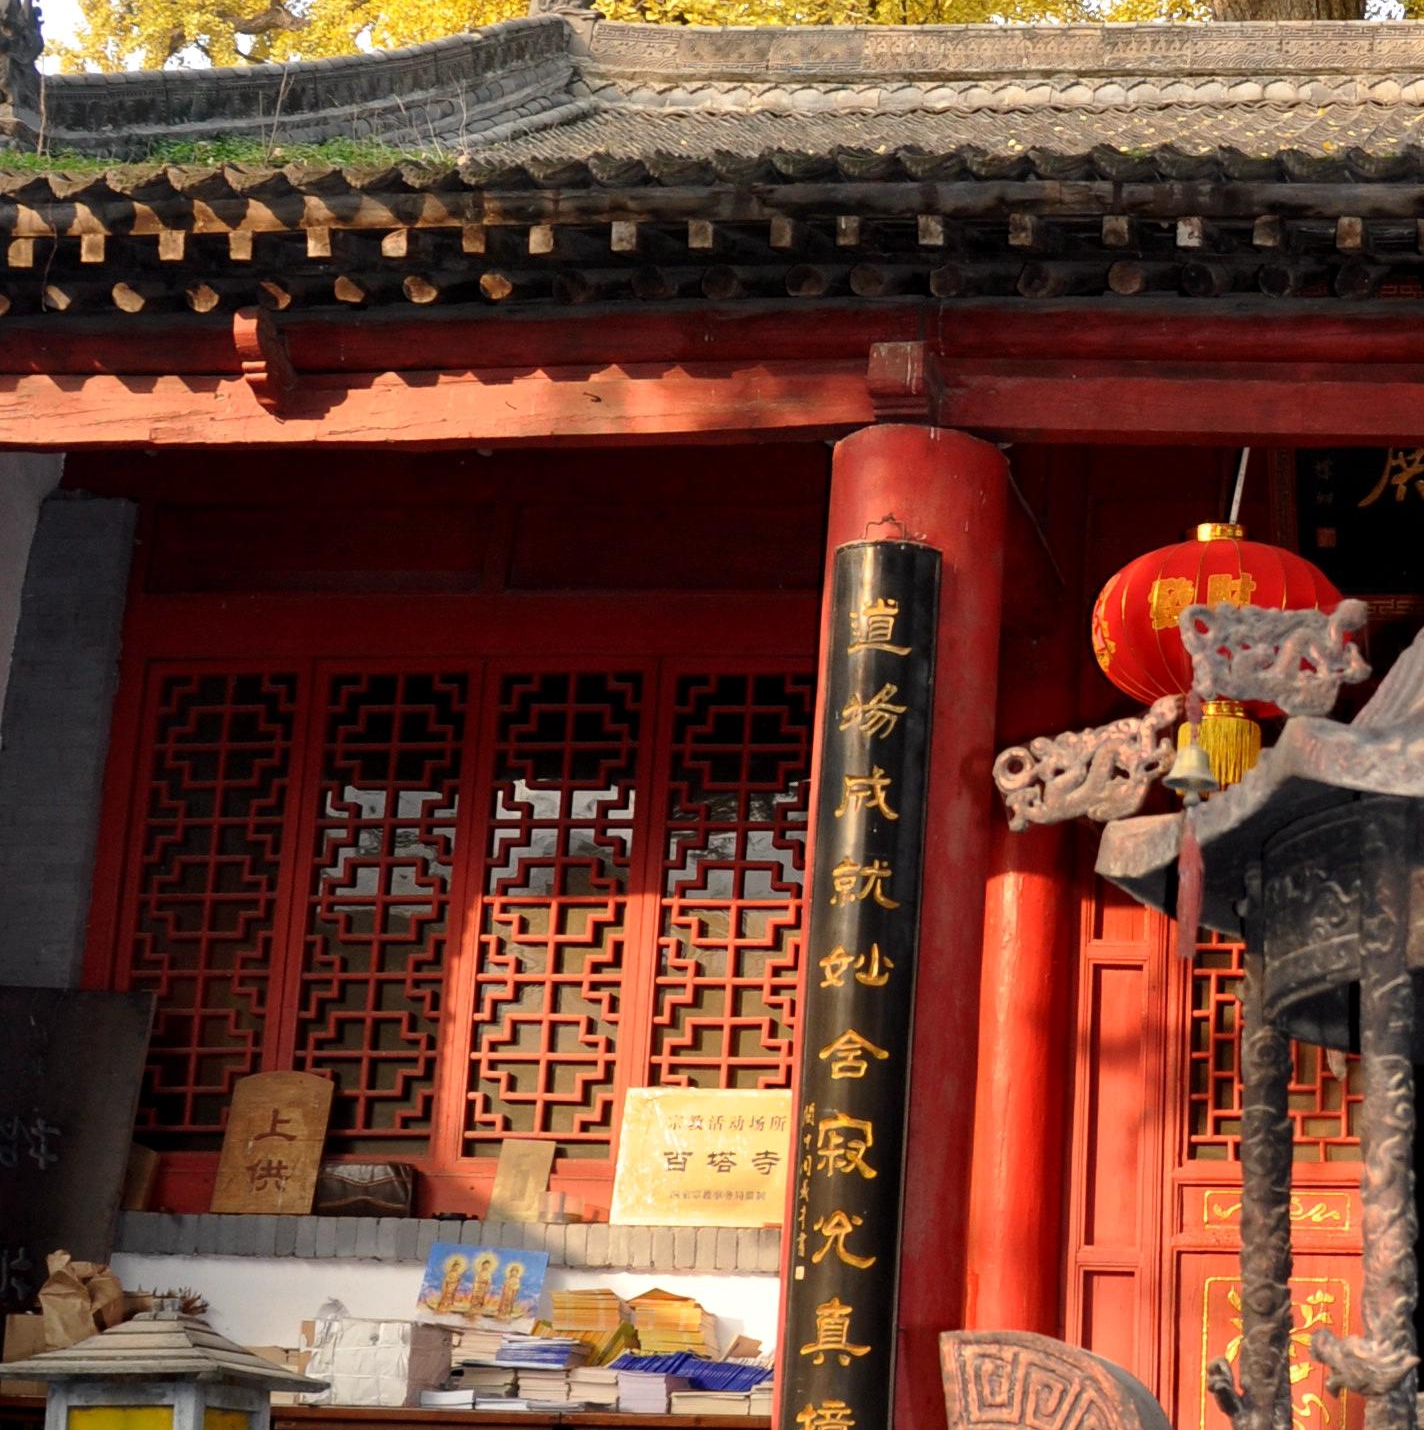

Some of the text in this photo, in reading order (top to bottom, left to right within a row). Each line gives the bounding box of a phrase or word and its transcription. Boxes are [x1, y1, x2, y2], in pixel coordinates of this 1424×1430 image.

[668, 1114, 787, 1132] 宗教活动场所
[246, 1107, 297, 1193] 上供
[663, 1149, 781, 1176] 百塔寺
